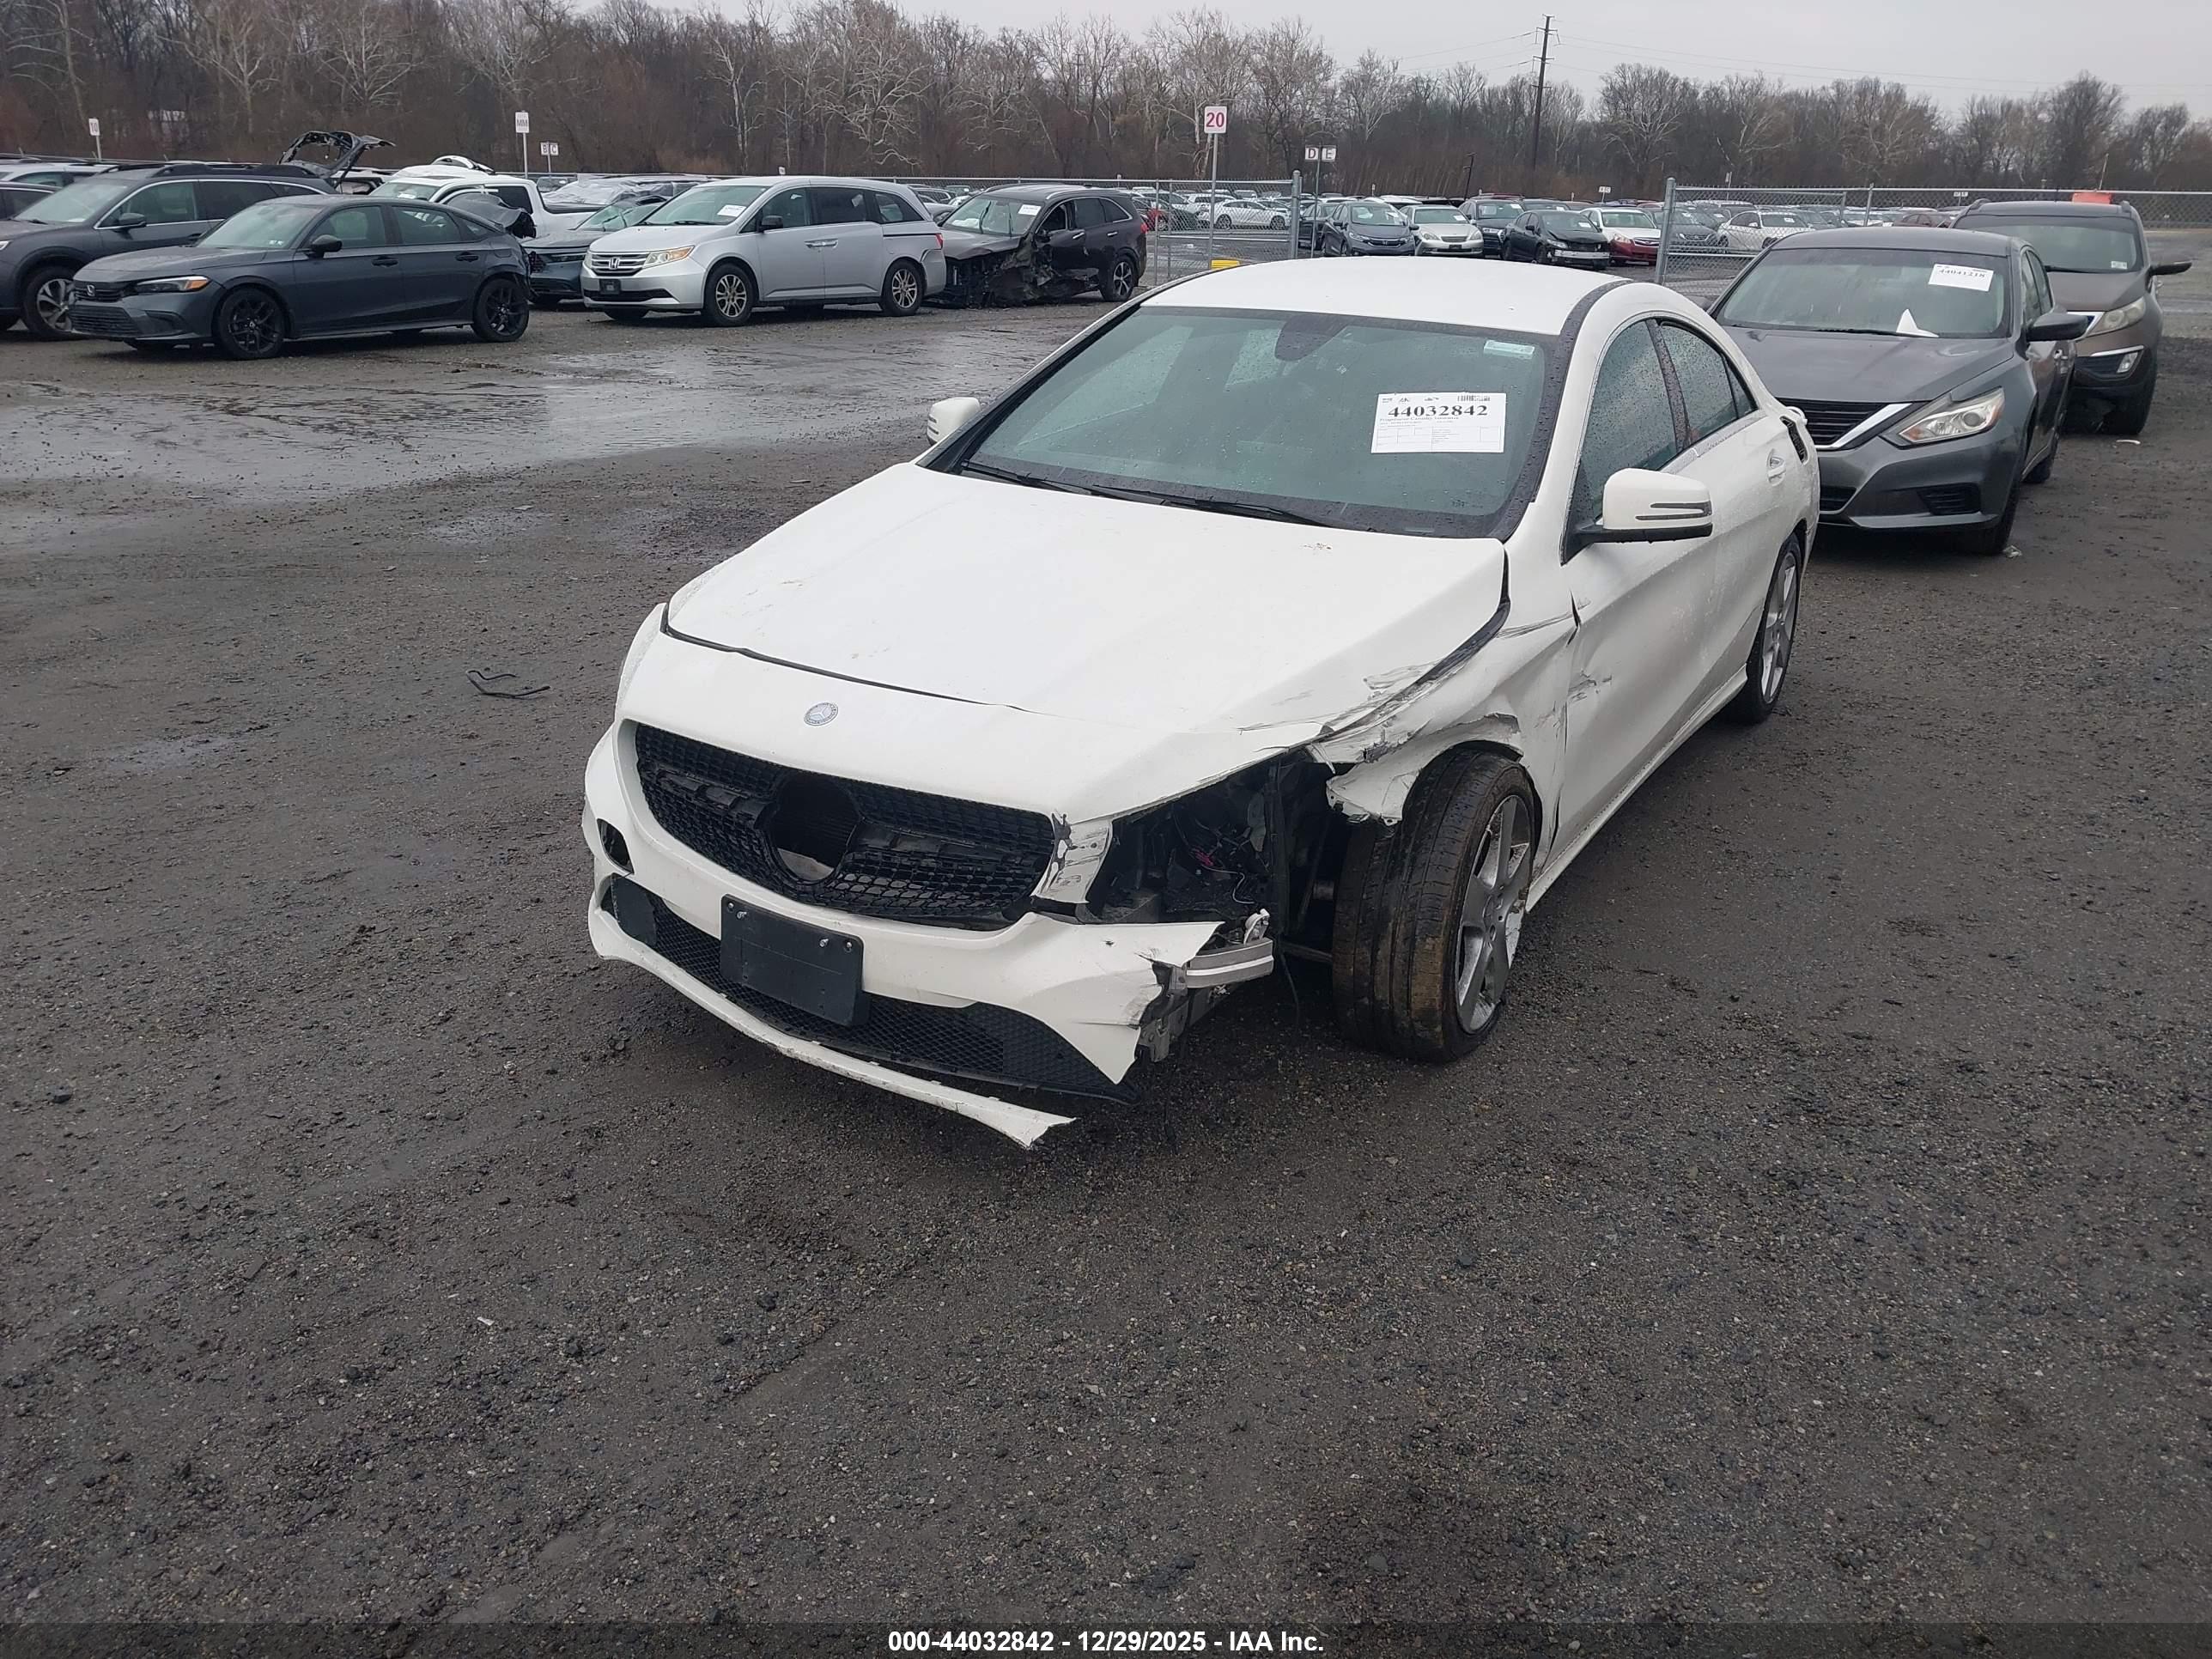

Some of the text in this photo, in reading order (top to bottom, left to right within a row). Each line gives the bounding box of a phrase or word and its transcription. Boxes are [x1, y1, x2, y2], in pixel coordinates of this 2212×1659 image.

[1206, 112, 1224, 127] 20
[1309, 148, 1316, 159] D
[1327, 149, 1333, 159] E
[1389, 405, 1488, 417] 44032842
